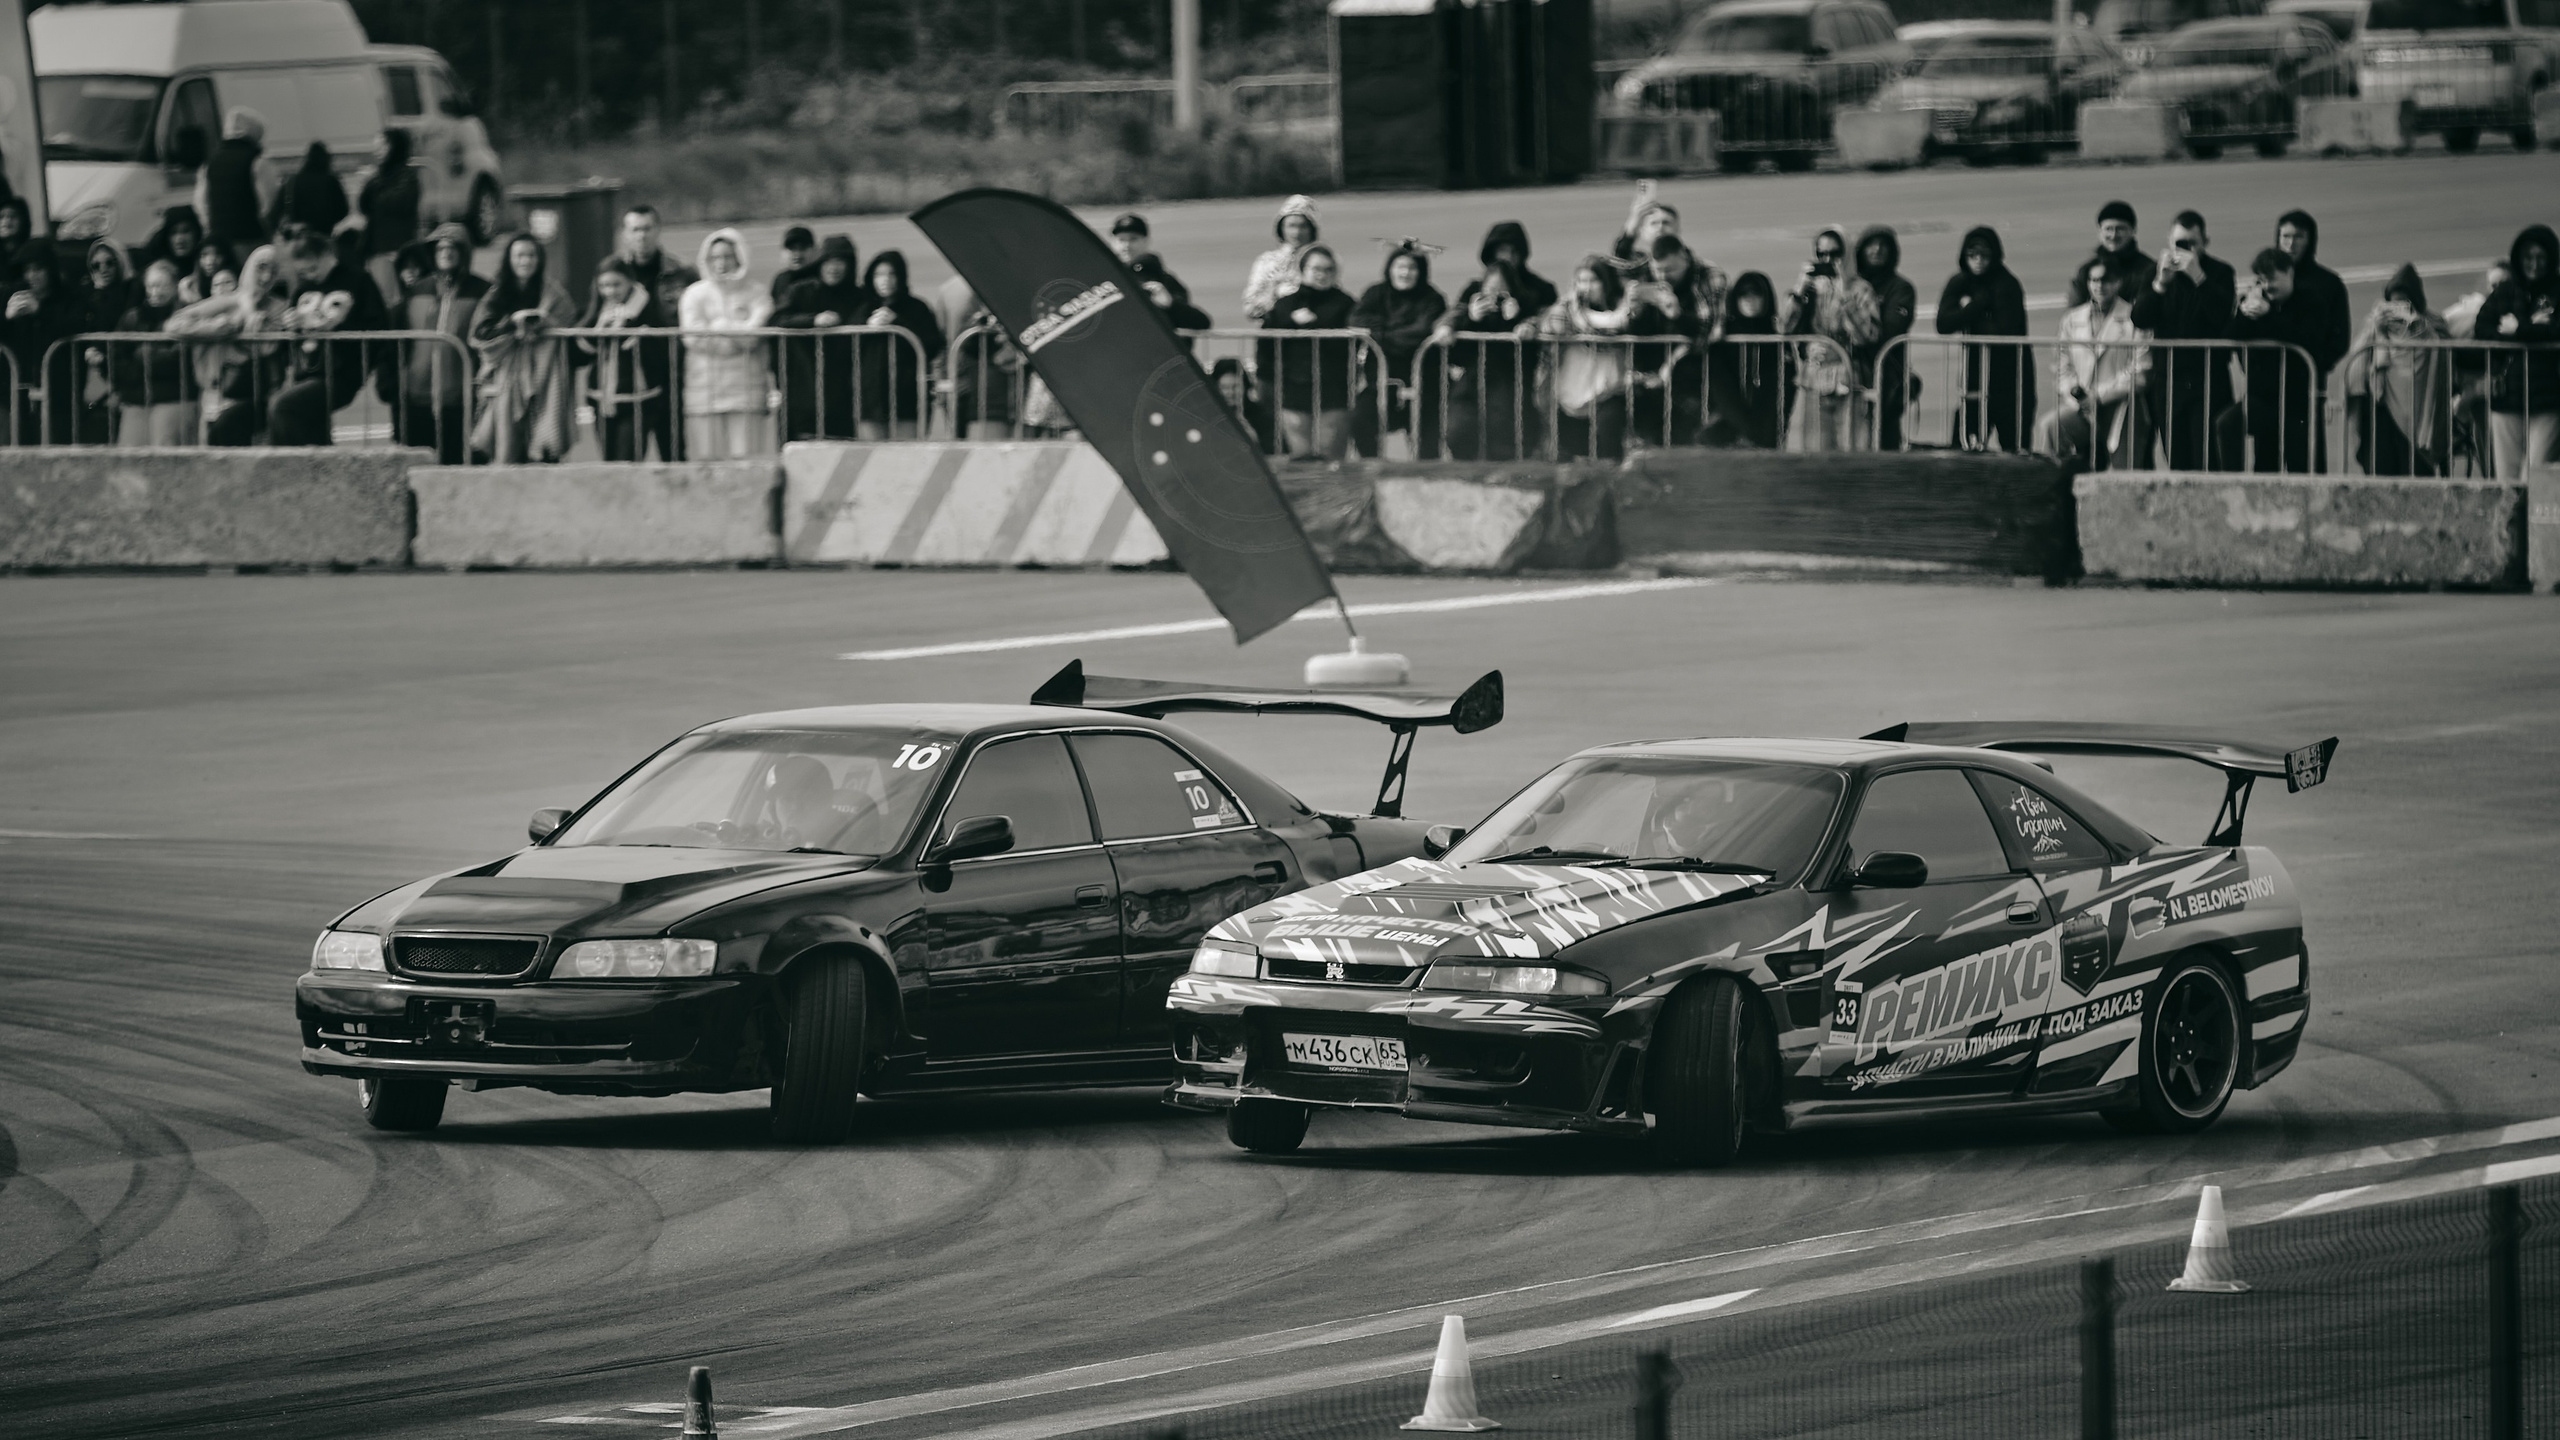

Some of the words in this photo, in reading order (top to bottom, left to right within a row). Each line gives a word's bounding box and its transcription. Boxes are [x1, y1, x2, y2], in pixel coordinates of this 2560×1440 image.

[892, 743, 942, 771] 10
[1185, 785, 1210, 811] 10
[2170, 898, 2187, 920] N.
[2188, 875, 2276, 916] BELOMESTNOV
[1265, 923, 1385, 939] ВЫШЕ
[1374, 929, 1451, 947] ЦЕНЫ
[1335, 915, 1481, 936] КАЧЕСТВО
[1836, 998, 1857, 1026] 33
[1855, 937, 2054, 1065] РЕМИКС
[1927, 1047, 1944, 1069] В
[1942, 1022, 2022, 1065] НАЛИЧИИ
[2026, 1017, 2042, 1040] И
[2048, 1006, 2087, 1035] ПОД
[2088, 989, 2144, 1024] ЗАКАЗ
[1379, 1042, 1400, 1060] 65
